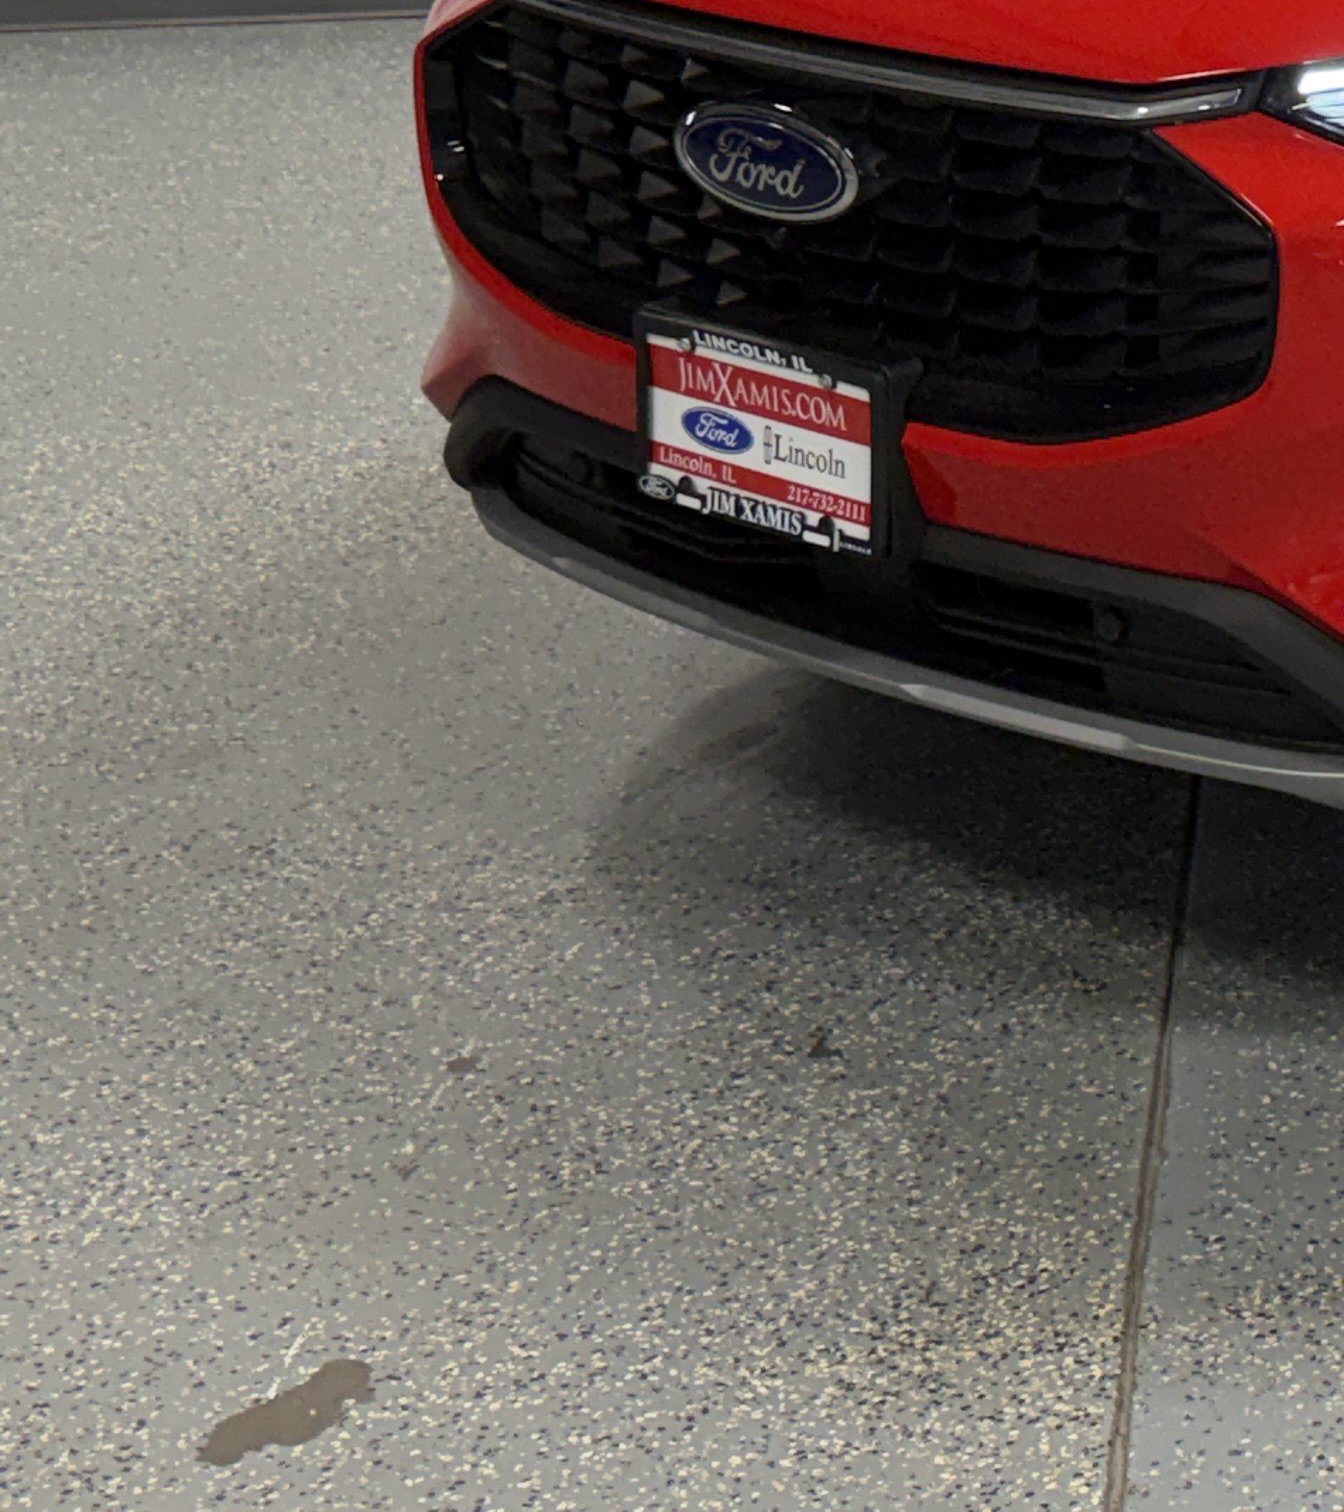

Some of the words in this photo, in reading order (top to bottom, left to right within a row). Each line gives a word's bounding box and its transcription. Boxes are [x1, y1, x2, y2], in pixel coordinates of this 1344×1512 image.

[708, 127, 805, 198] Ford
[692, 330, 787, 367] LINCOLN,
[791, 354, 814, 373] IL
[677, 356, 848, 432] JIMXAMIS.COM
[694, 412, 740, 449] Ford
[721, 465, 737, 484] IL
[774, 433, 846, 479] Lincoln
[702, 488, 736, 518] JIM
[740, 498, 803, 536] XAMIS
[787, 485, 867, 522] 217-732-2111
